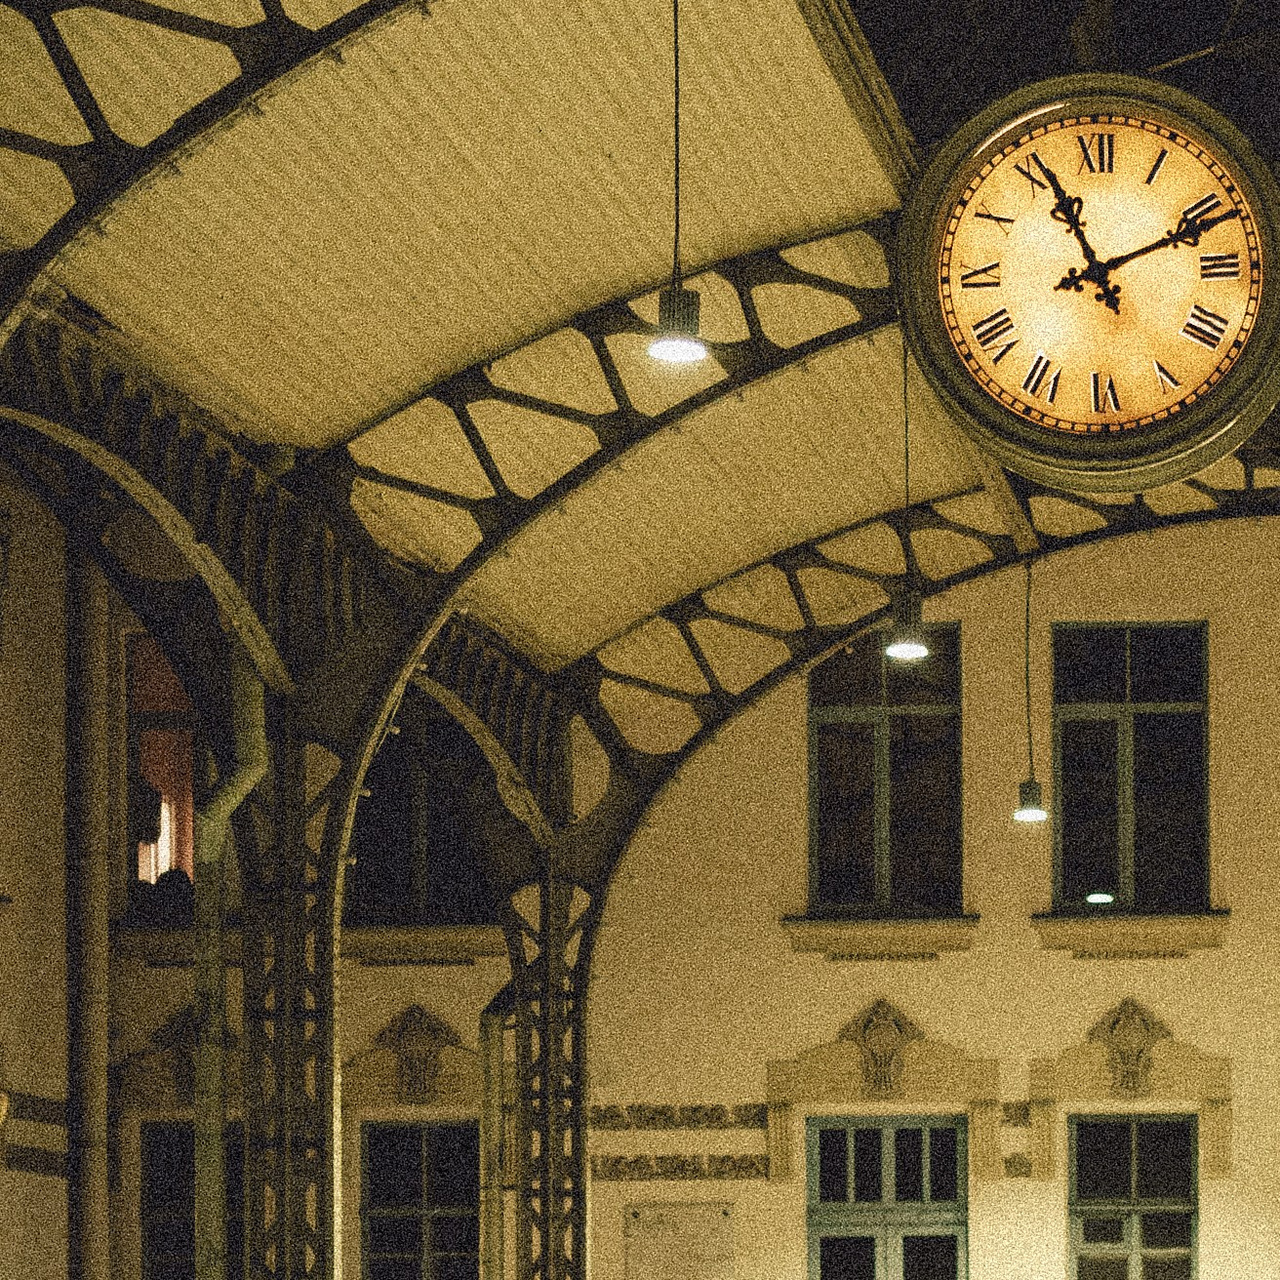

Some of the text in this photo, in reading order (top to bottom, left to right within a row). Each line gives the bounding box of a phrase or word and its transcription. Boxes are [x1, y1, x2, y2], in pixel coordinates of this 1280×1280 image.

[1077, 133, 1114, 174] XII
[1145, 149, 1168, 185] I
[974, 200, 1014, 236] X
[961, 261, 1000, 289] IX
[1200, 252, 1239, 280] III
[972, 308, 1020, 365] VIII
[1182, 305, 1229, 350] IIII
[1021, 355, 1062, 404] VII
[1092, 372, 1121, 413] VI
[1153, 359, 1182, 395] V
